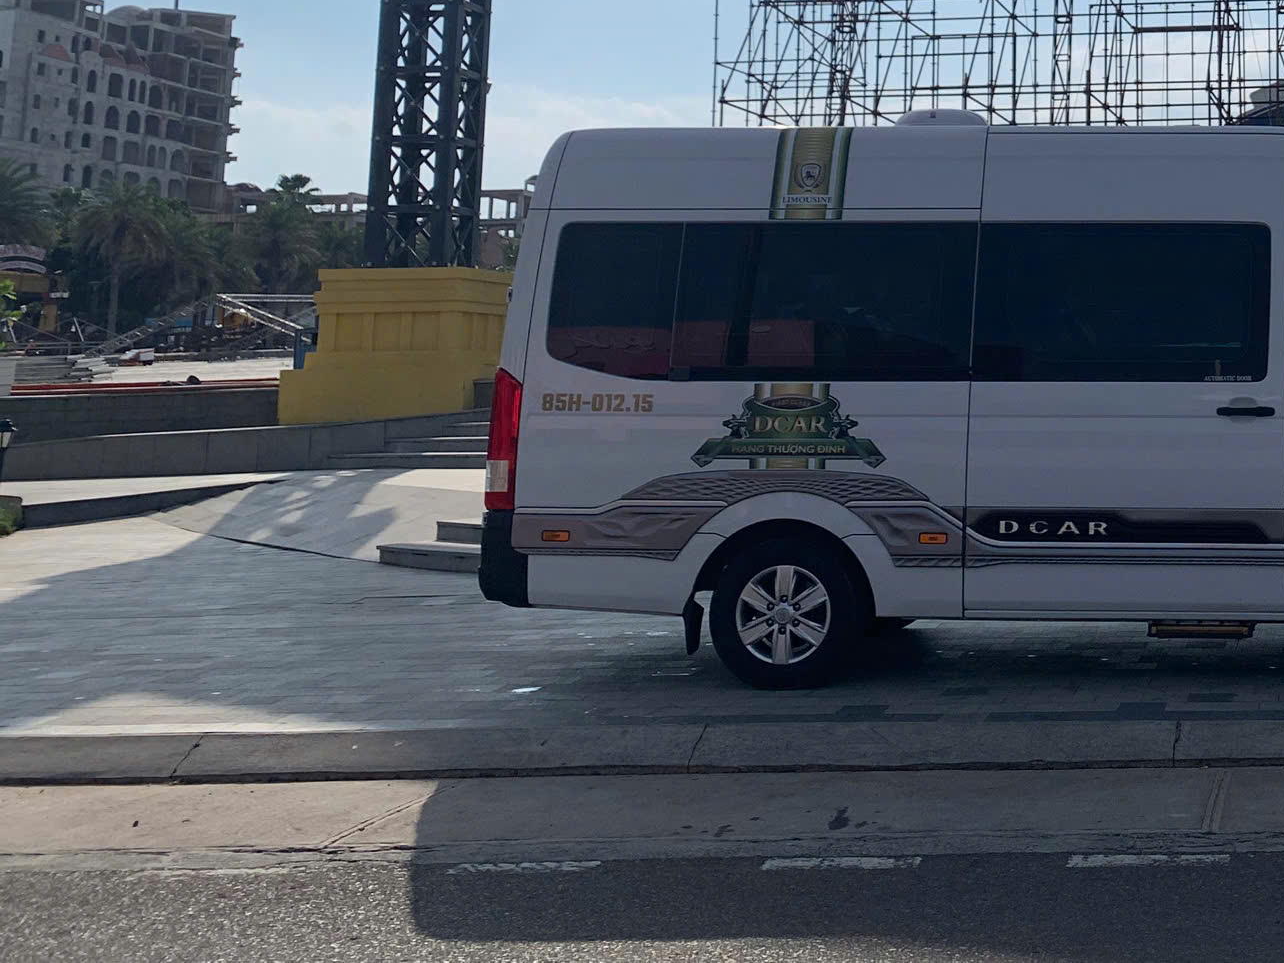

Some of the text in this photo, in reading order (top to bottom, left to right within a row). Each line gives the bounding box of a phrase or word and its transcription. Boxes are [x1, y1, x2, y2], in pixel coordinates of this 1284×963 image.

[541, 392, 654, 413] 85H-012.15
[753, 416, 828, 433] DCAR
[999, 520, 1107, 535] DCAR
